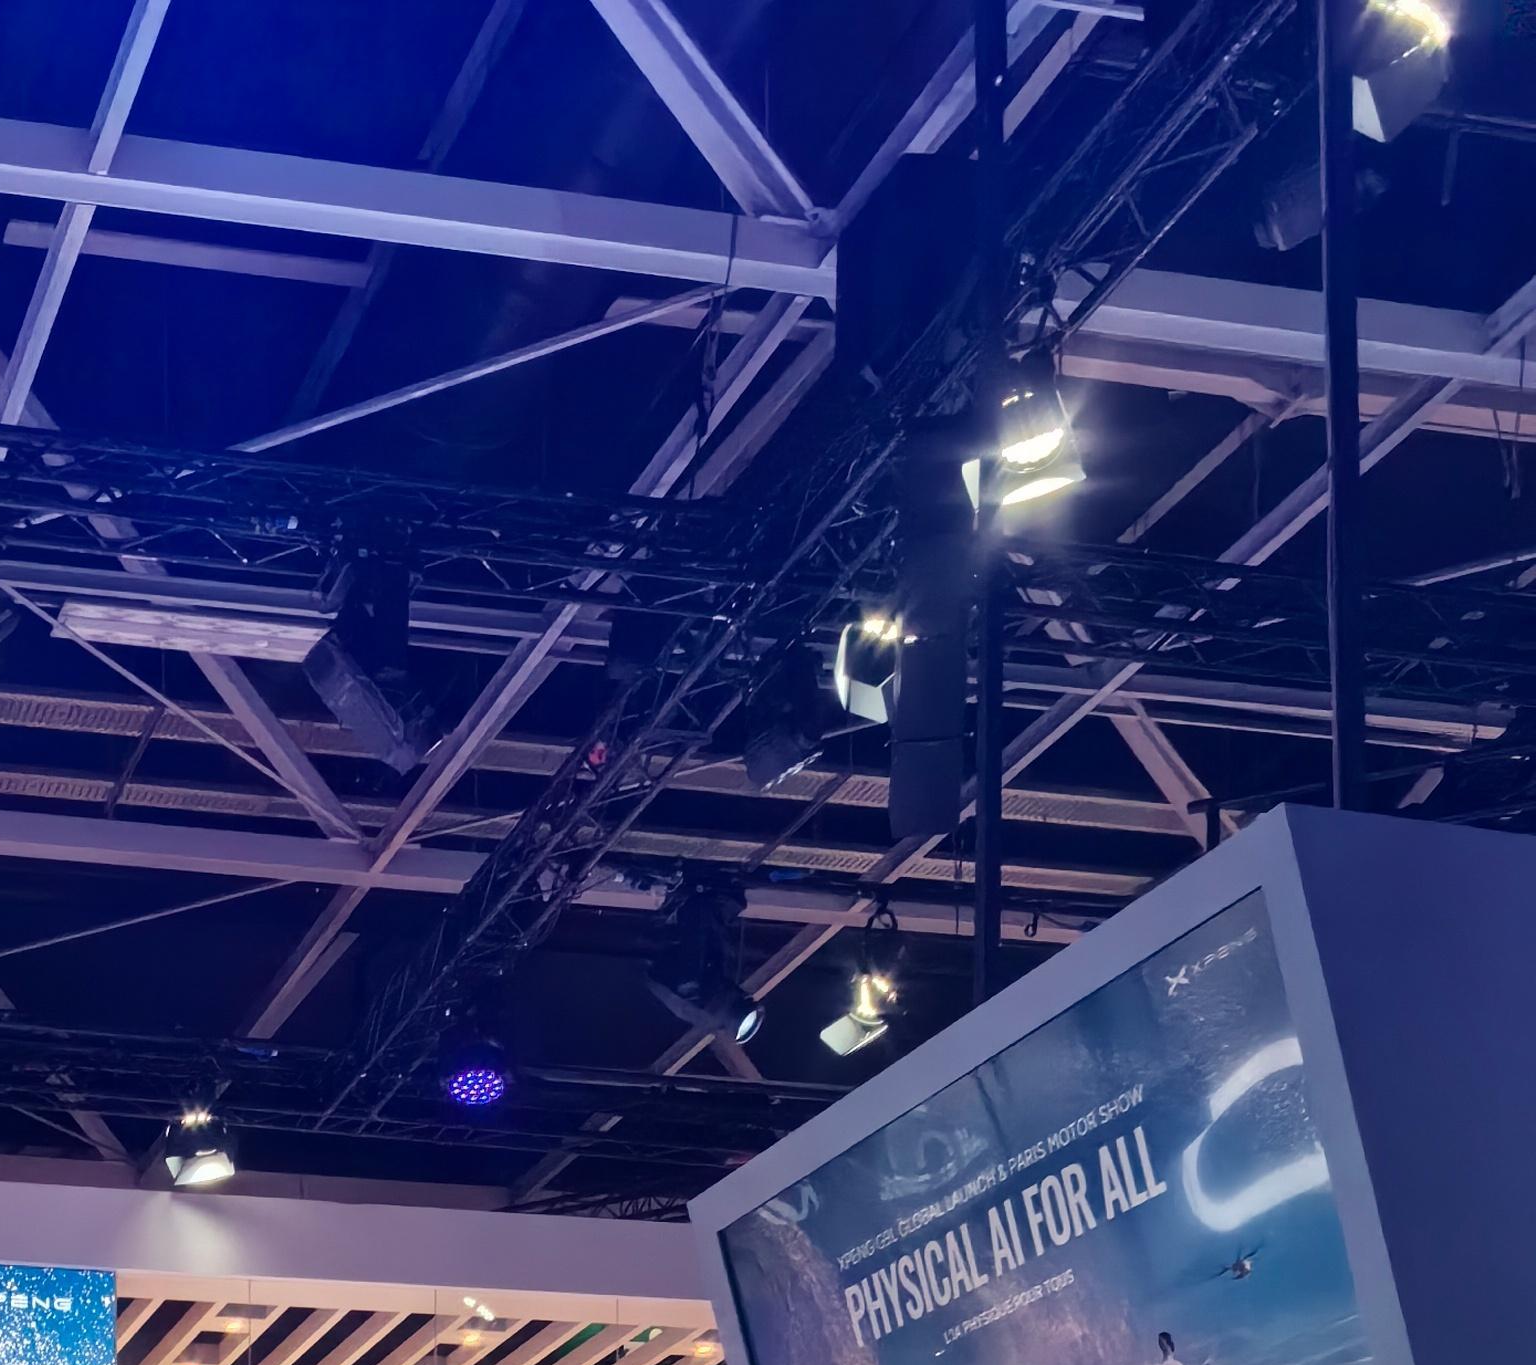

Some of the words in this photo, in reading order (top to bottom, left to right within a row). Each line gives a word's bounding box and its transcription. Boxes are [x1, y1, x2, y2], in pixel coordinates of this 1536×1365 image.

[1008, 1141, 1047, 1175] PARIS
[1047, 1109, 1098, 1153] MOTOR
[1098, 1084, 1144, 1124] SHOW
[844, 1222, 990, 1348] PHYSICAL
[988, 1198, 1026, 1277] AI
[1022, 1163, 1097, 1257] FOR
[1098, 1126, 1167, 1220] ALL
